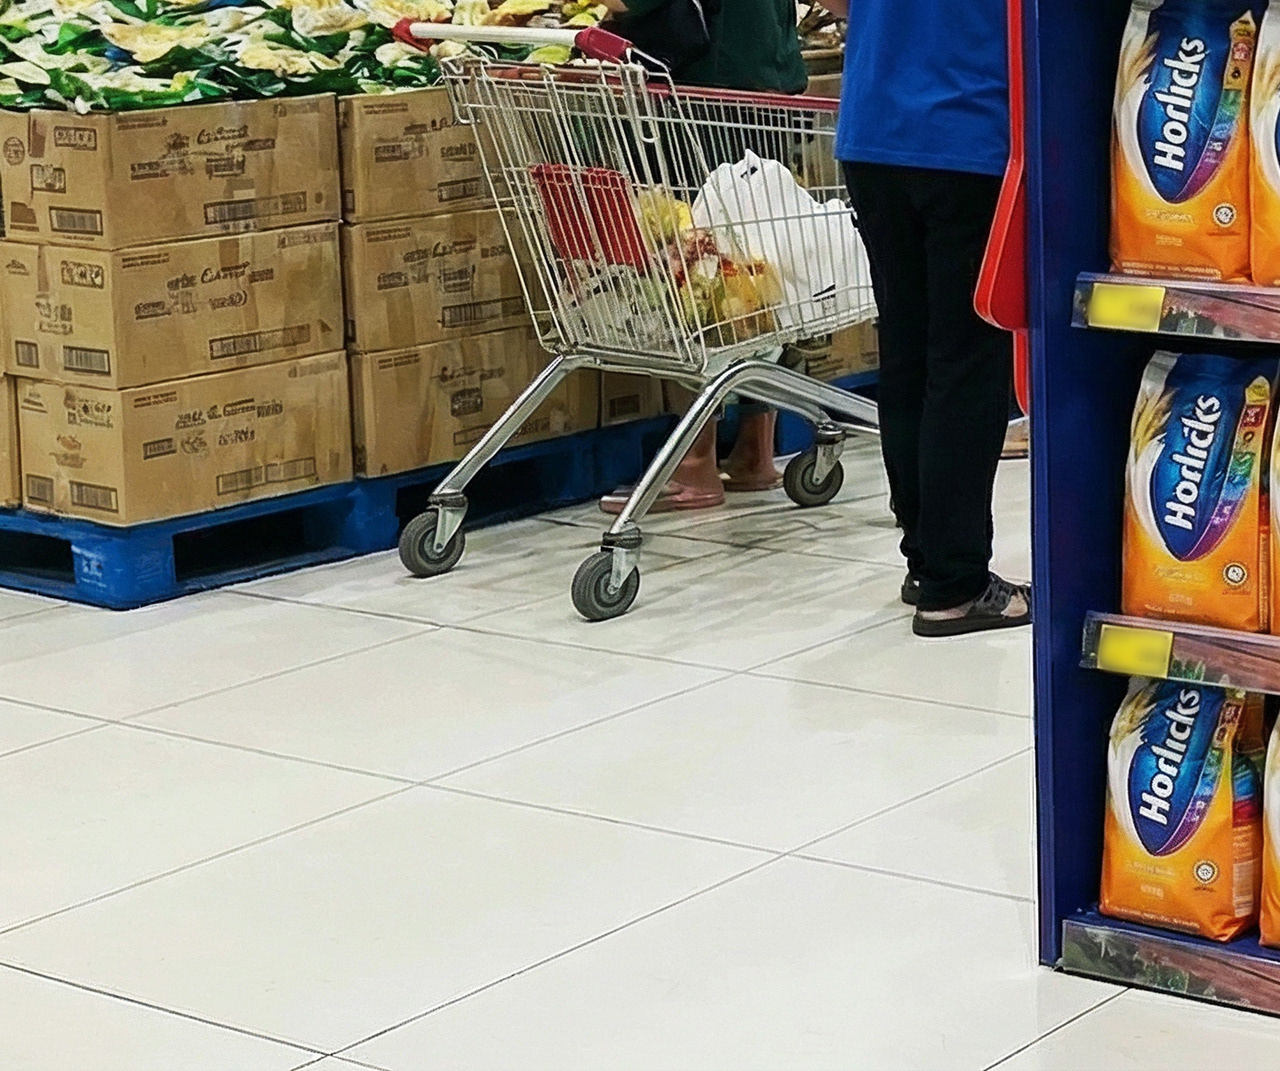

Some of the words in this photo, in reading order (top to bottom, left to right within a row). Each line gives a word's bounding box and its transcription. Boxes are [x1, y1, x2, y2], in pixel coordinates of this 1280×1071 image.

[1154, 37, 1207, 171] Horlicks
[1164, 394, 1222, 530] Horlicks
[1138, 687, 1201, 826] Horlicks
